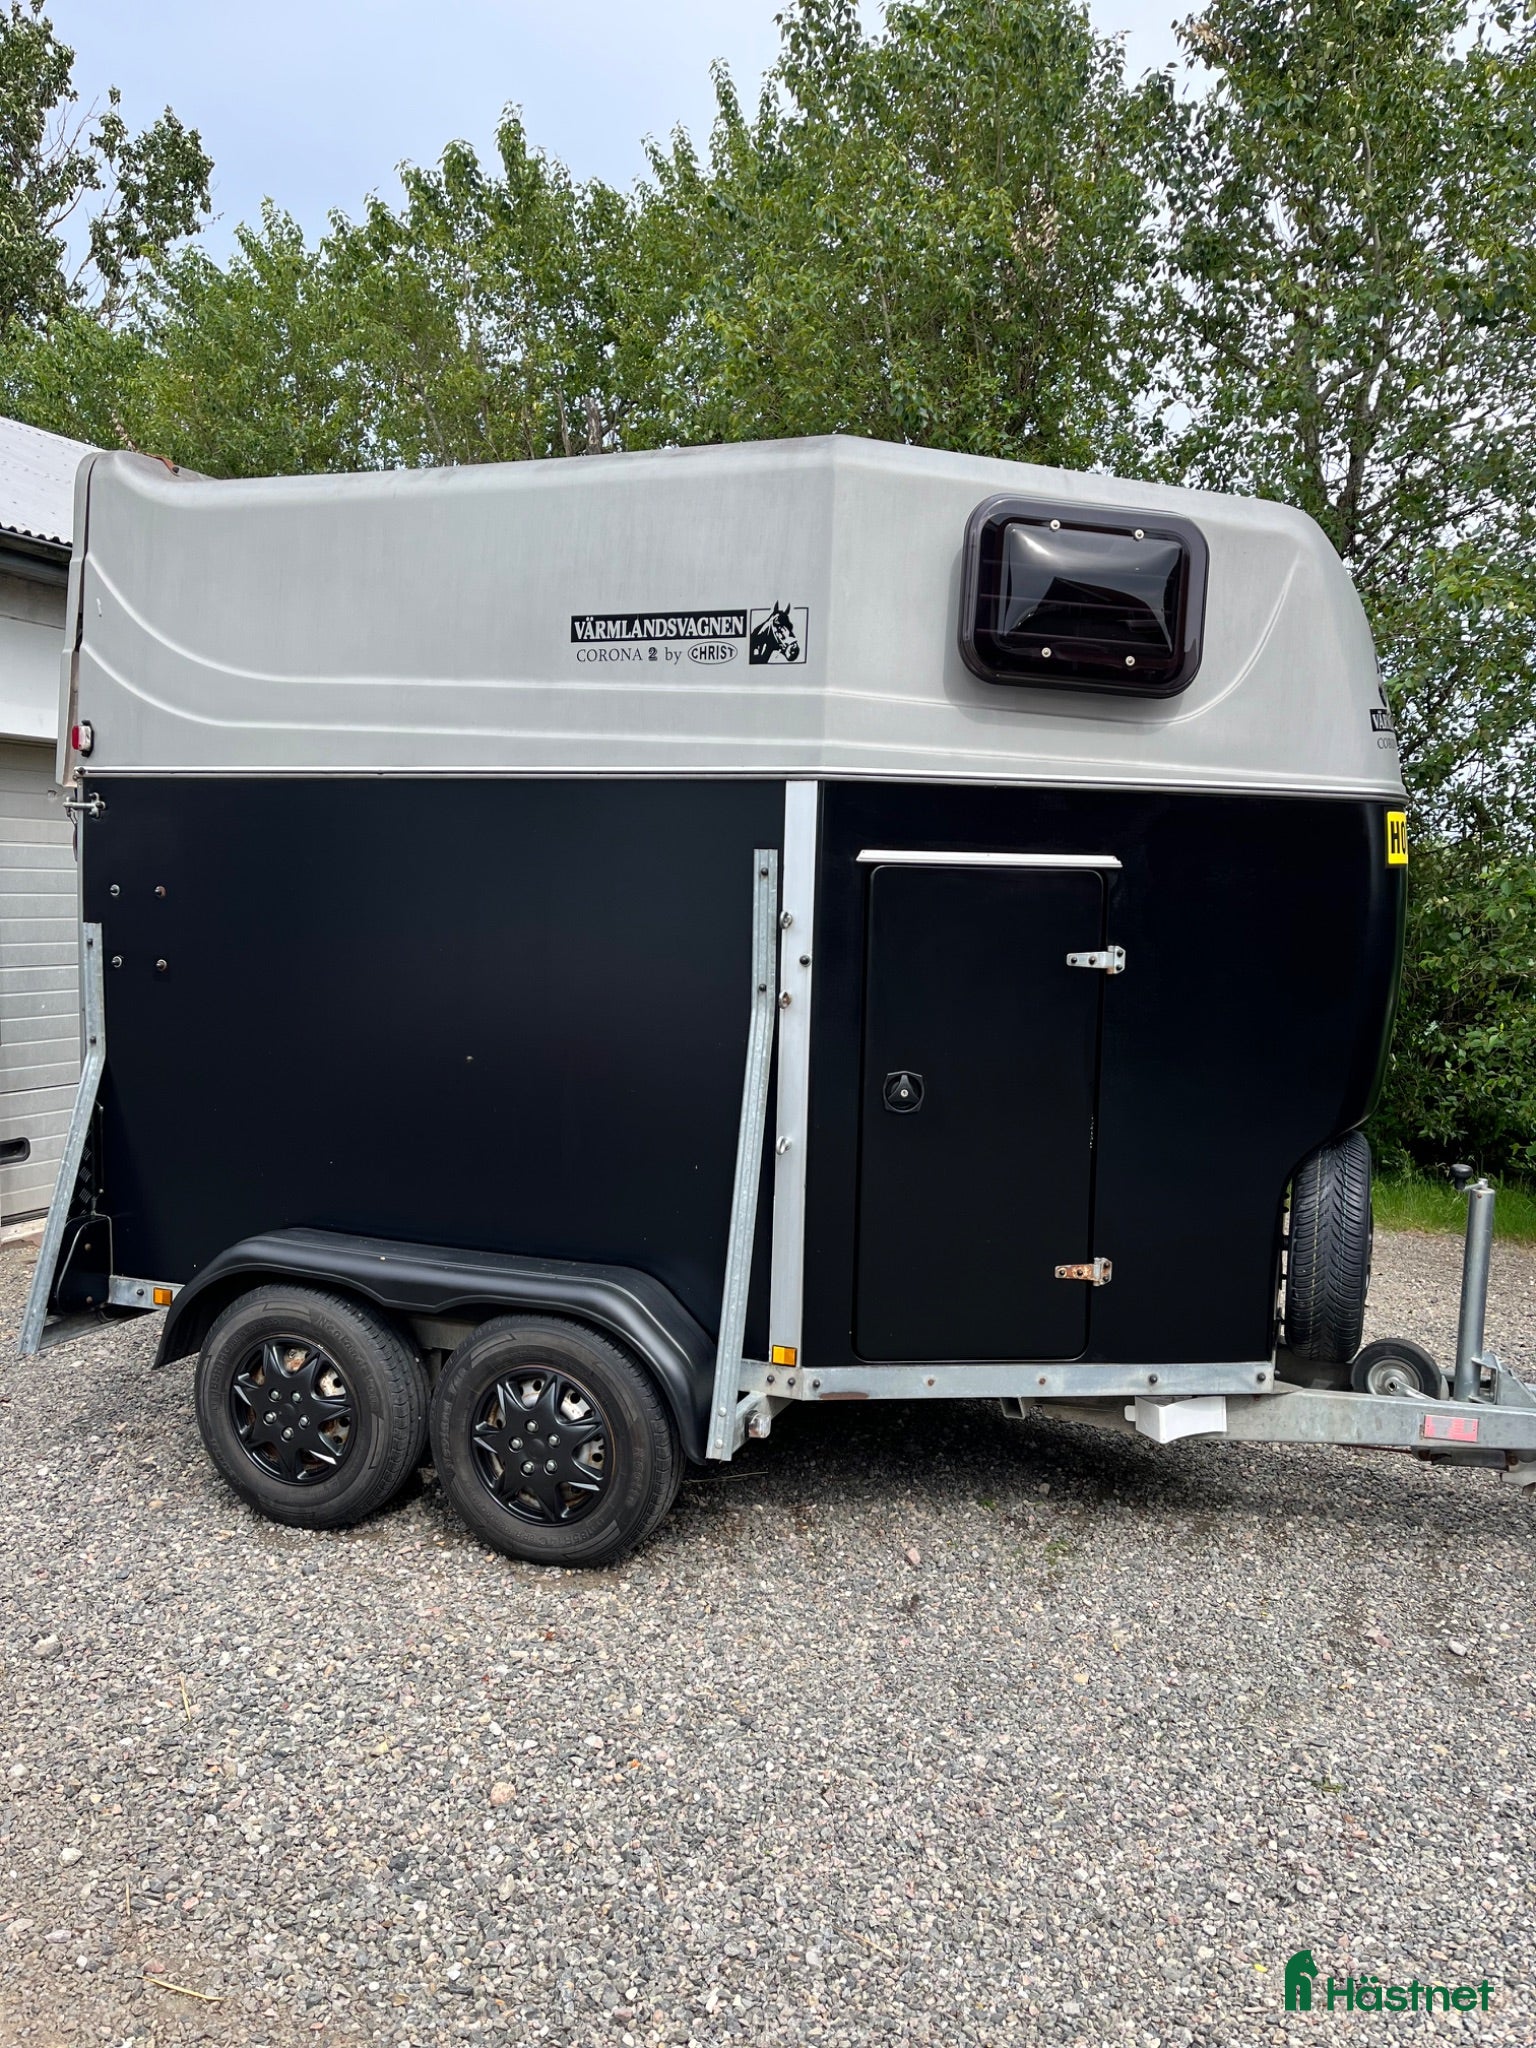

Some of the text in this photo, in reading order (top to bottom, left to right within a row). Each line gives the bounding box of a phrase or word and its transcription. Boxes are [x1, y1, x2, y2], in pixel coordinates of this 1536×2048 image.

[574, 616, 744, 640] VÄRMLANDSVAGNEN
[576, 645, 736, 665] CORONA 2 by CHRIST
